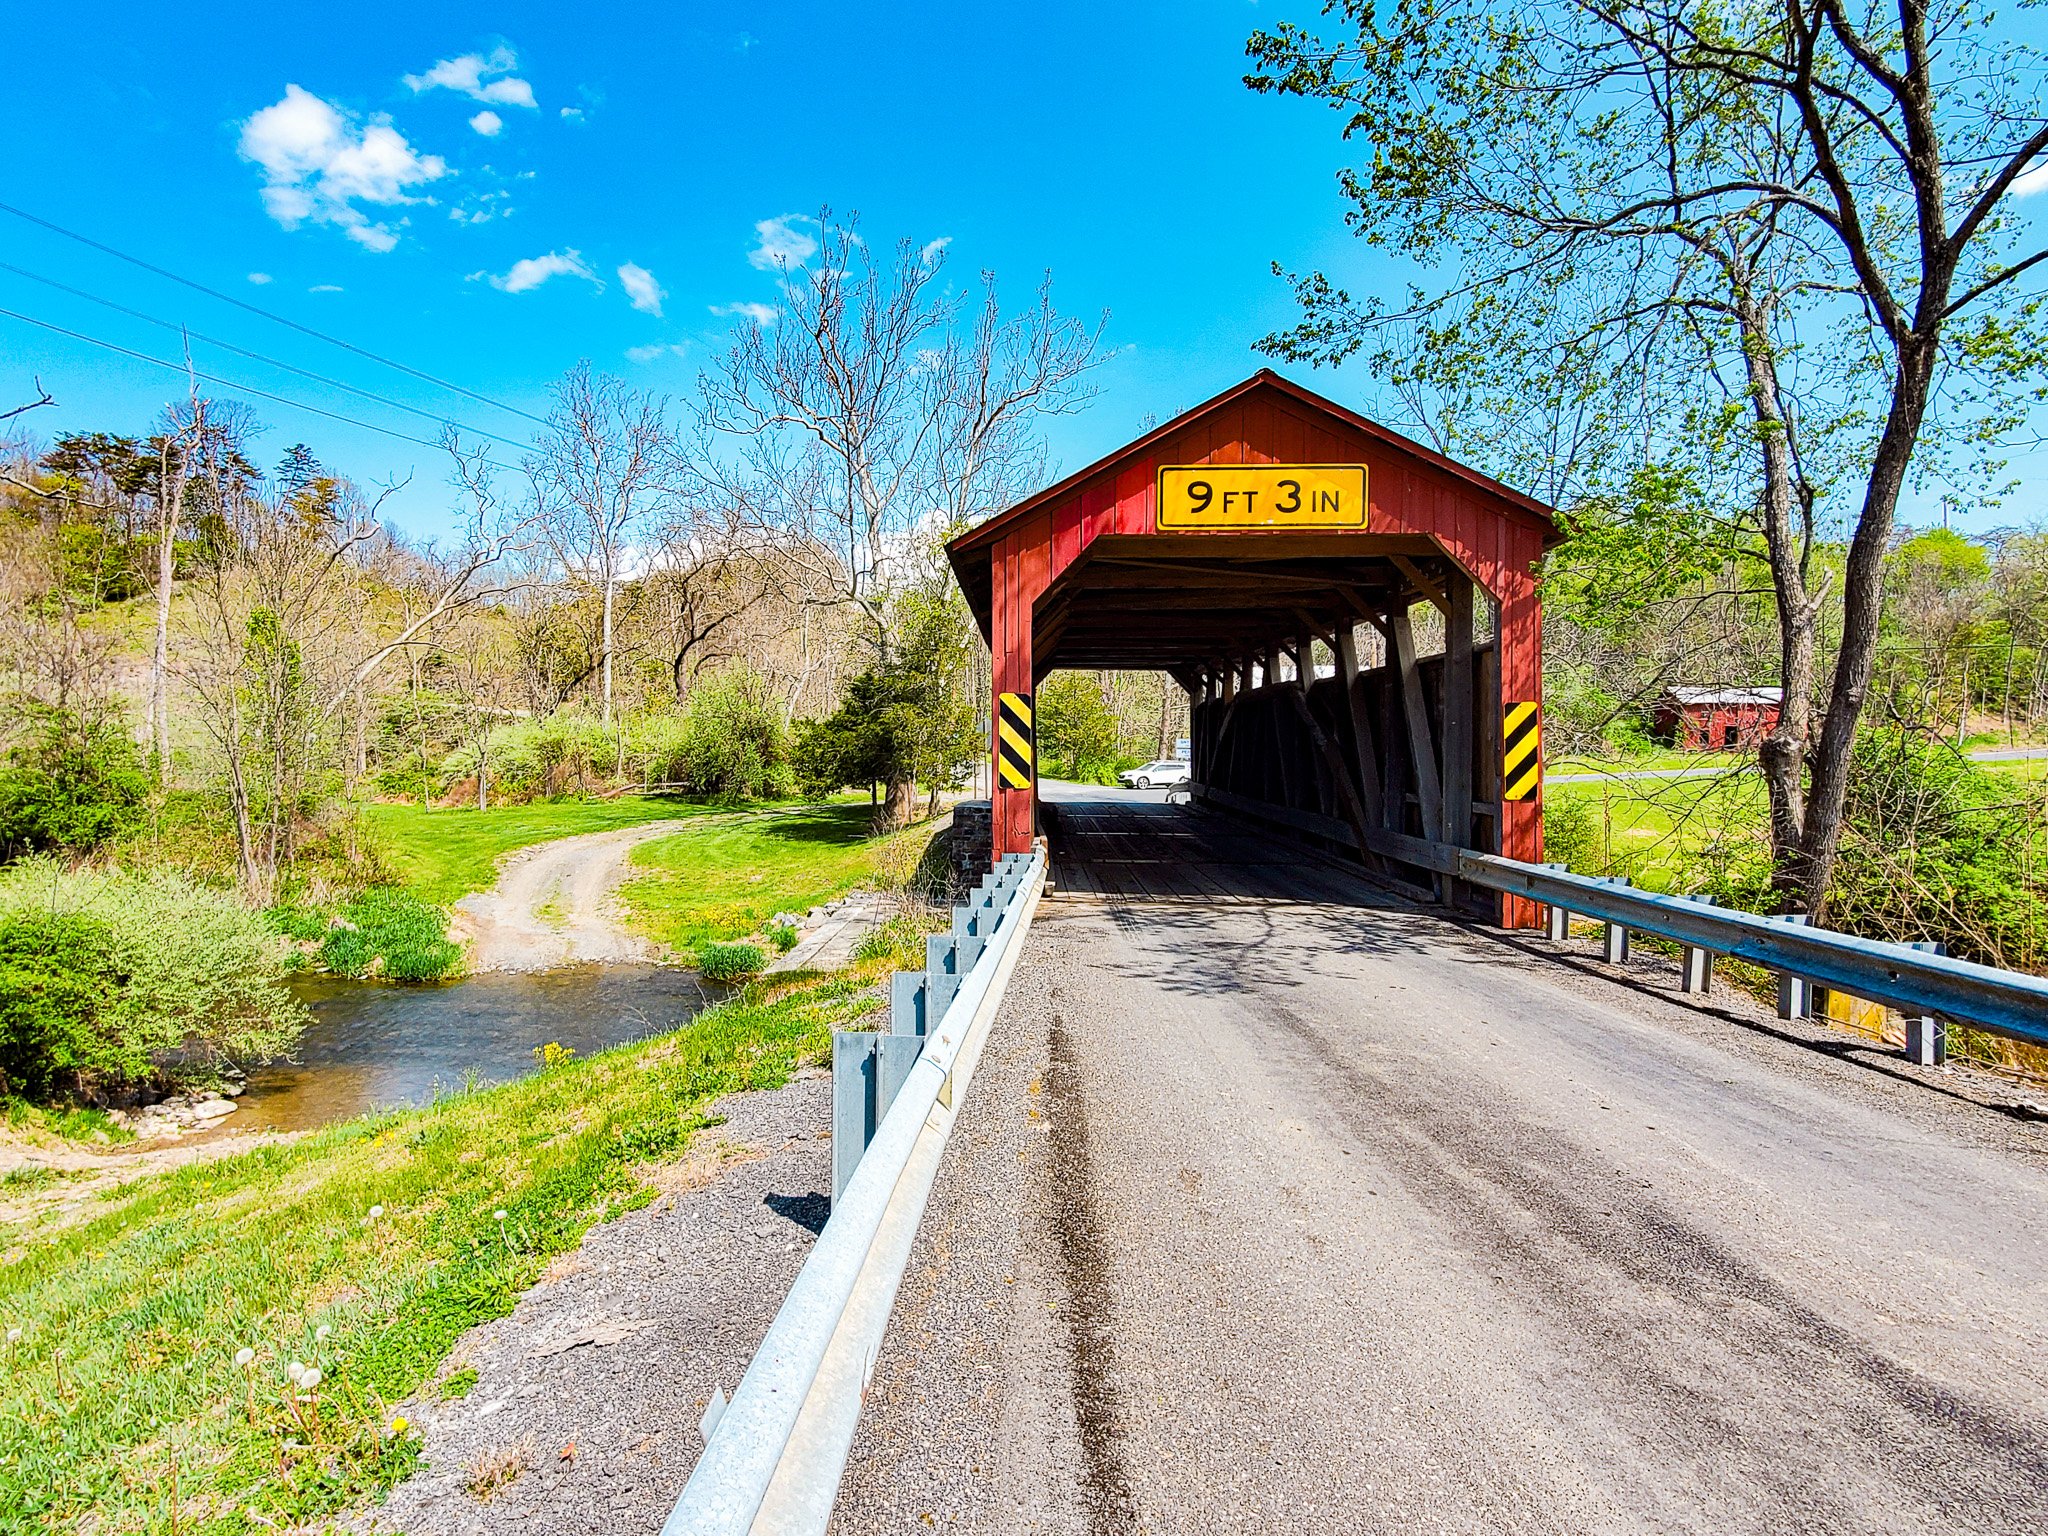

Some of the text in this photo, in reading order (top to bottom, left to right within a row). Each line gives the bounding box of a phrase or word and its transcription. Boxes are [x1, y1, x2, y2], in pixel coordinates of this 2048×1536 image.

[1187, 479, 1340, 514] 9 FT 3 IN
